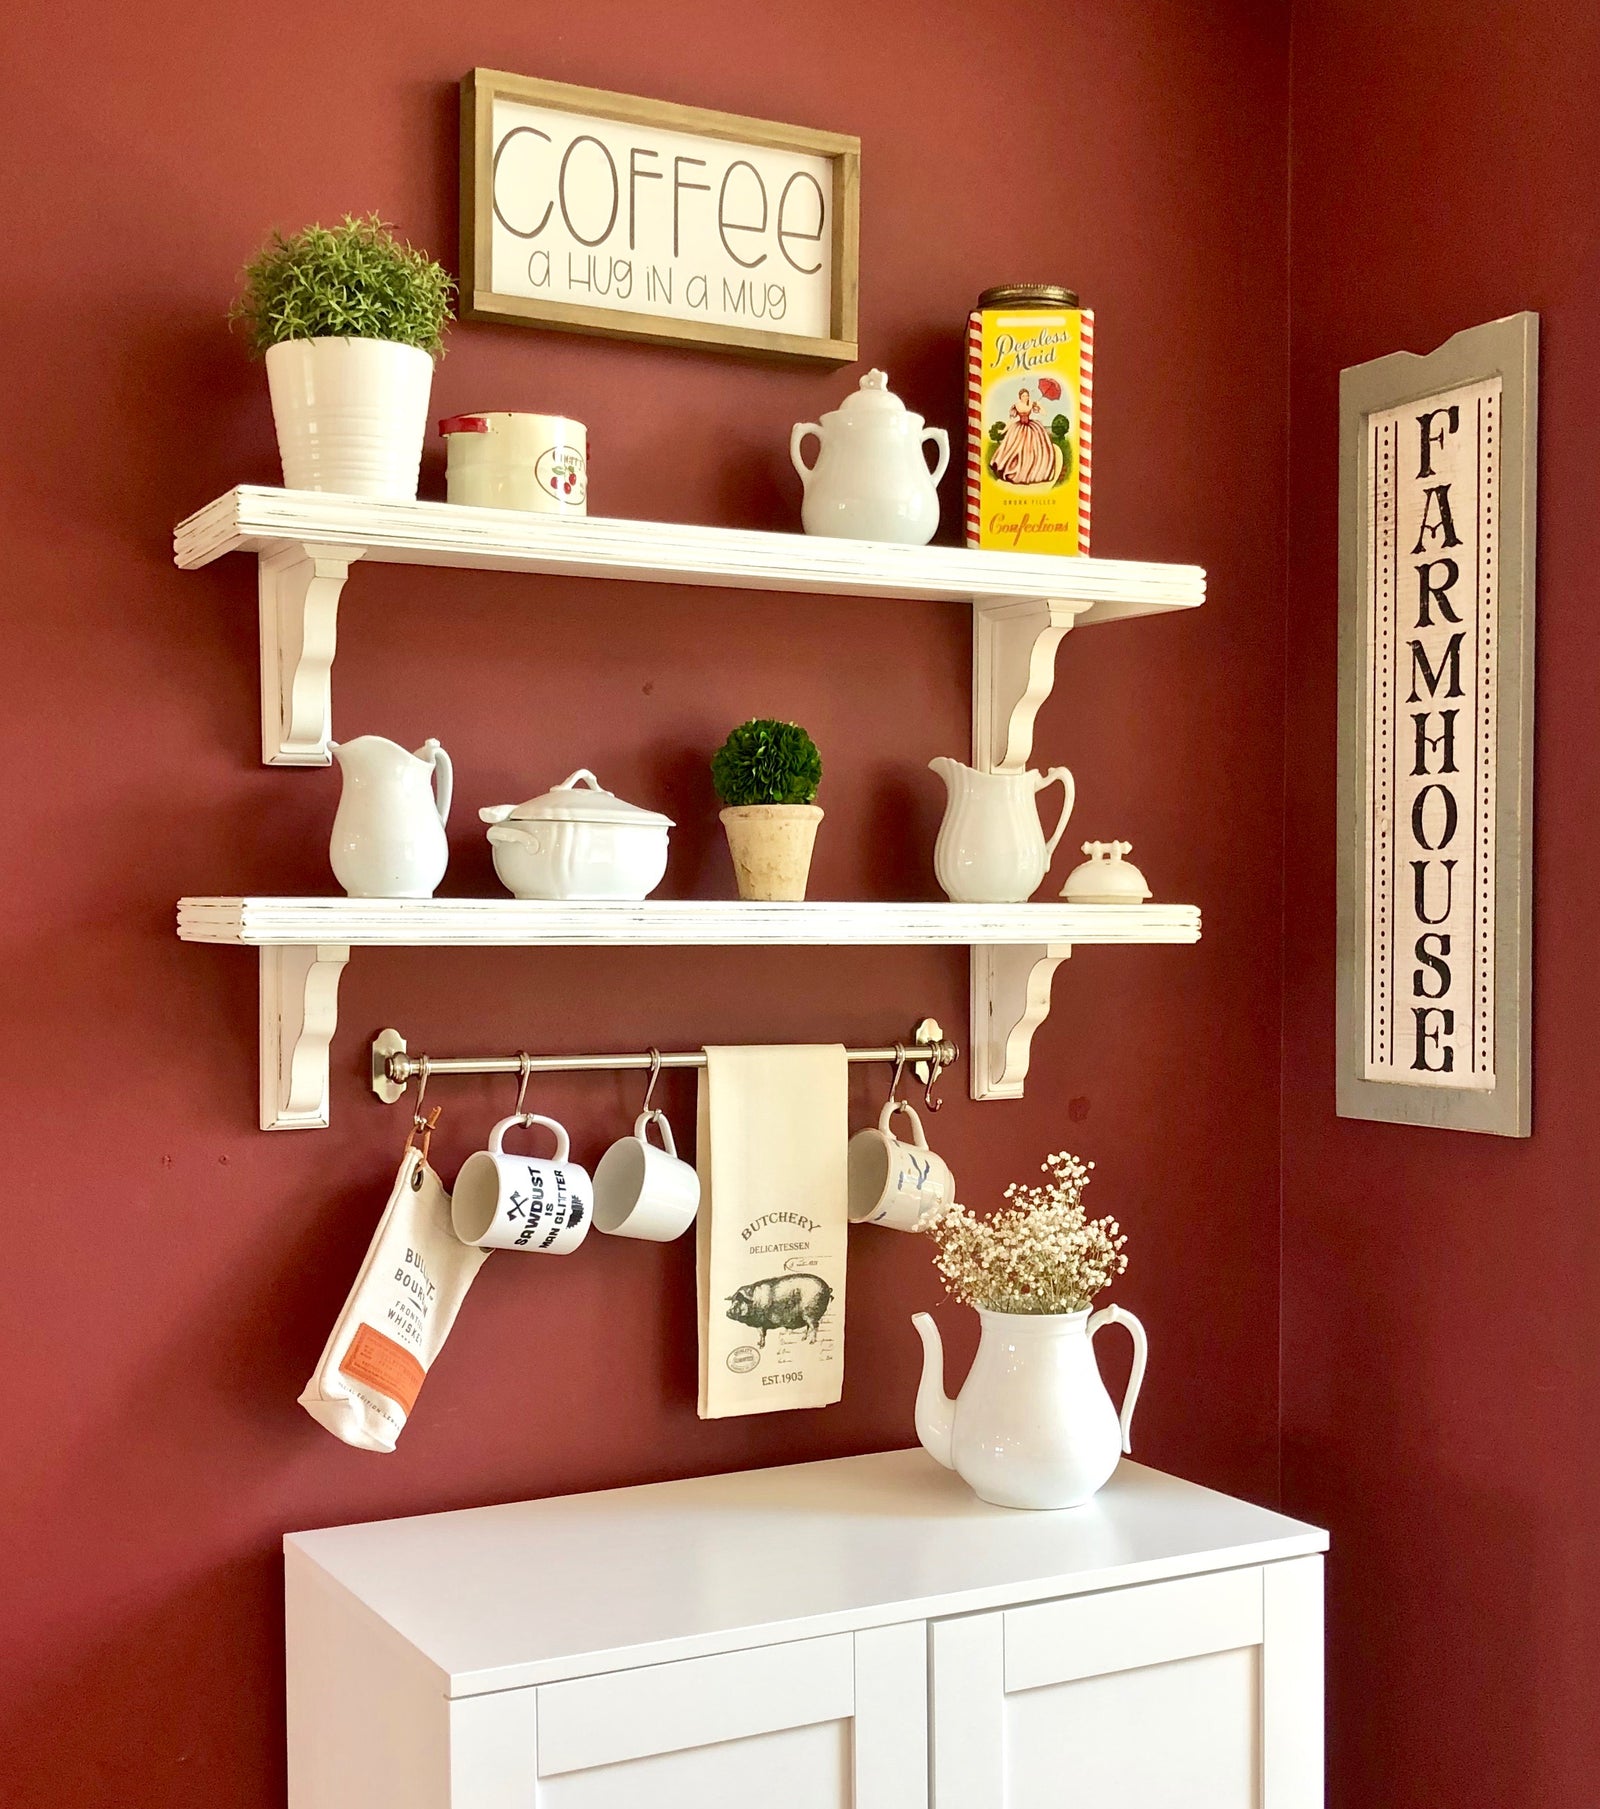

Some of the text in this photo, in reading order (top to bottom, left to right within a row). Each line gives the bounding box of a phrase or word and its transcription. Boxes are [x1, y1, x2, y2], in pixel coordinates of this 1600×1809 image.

[528, 250, 551, 288] a
[686, 274, 708, 310] a
[990, 328, 1069, 368] Peerless
[1006, 347, 1057, 371] Maid
[989, 512, 1069, 546] Confections
[1406, 405, 1467, 1074] FARMHOUSE
[514, 1166, 544, 1246] SAWDUST
[538, 1169, 567, 1249] MAN GLITTER
[544, 1203, 554, 1217] IS
[741, 1211, 822, 1241] BUTCHERY
[749, 1241, 810, 1255] DELICATESSEN
[761, 1371, 804, 1386] EST.1905
